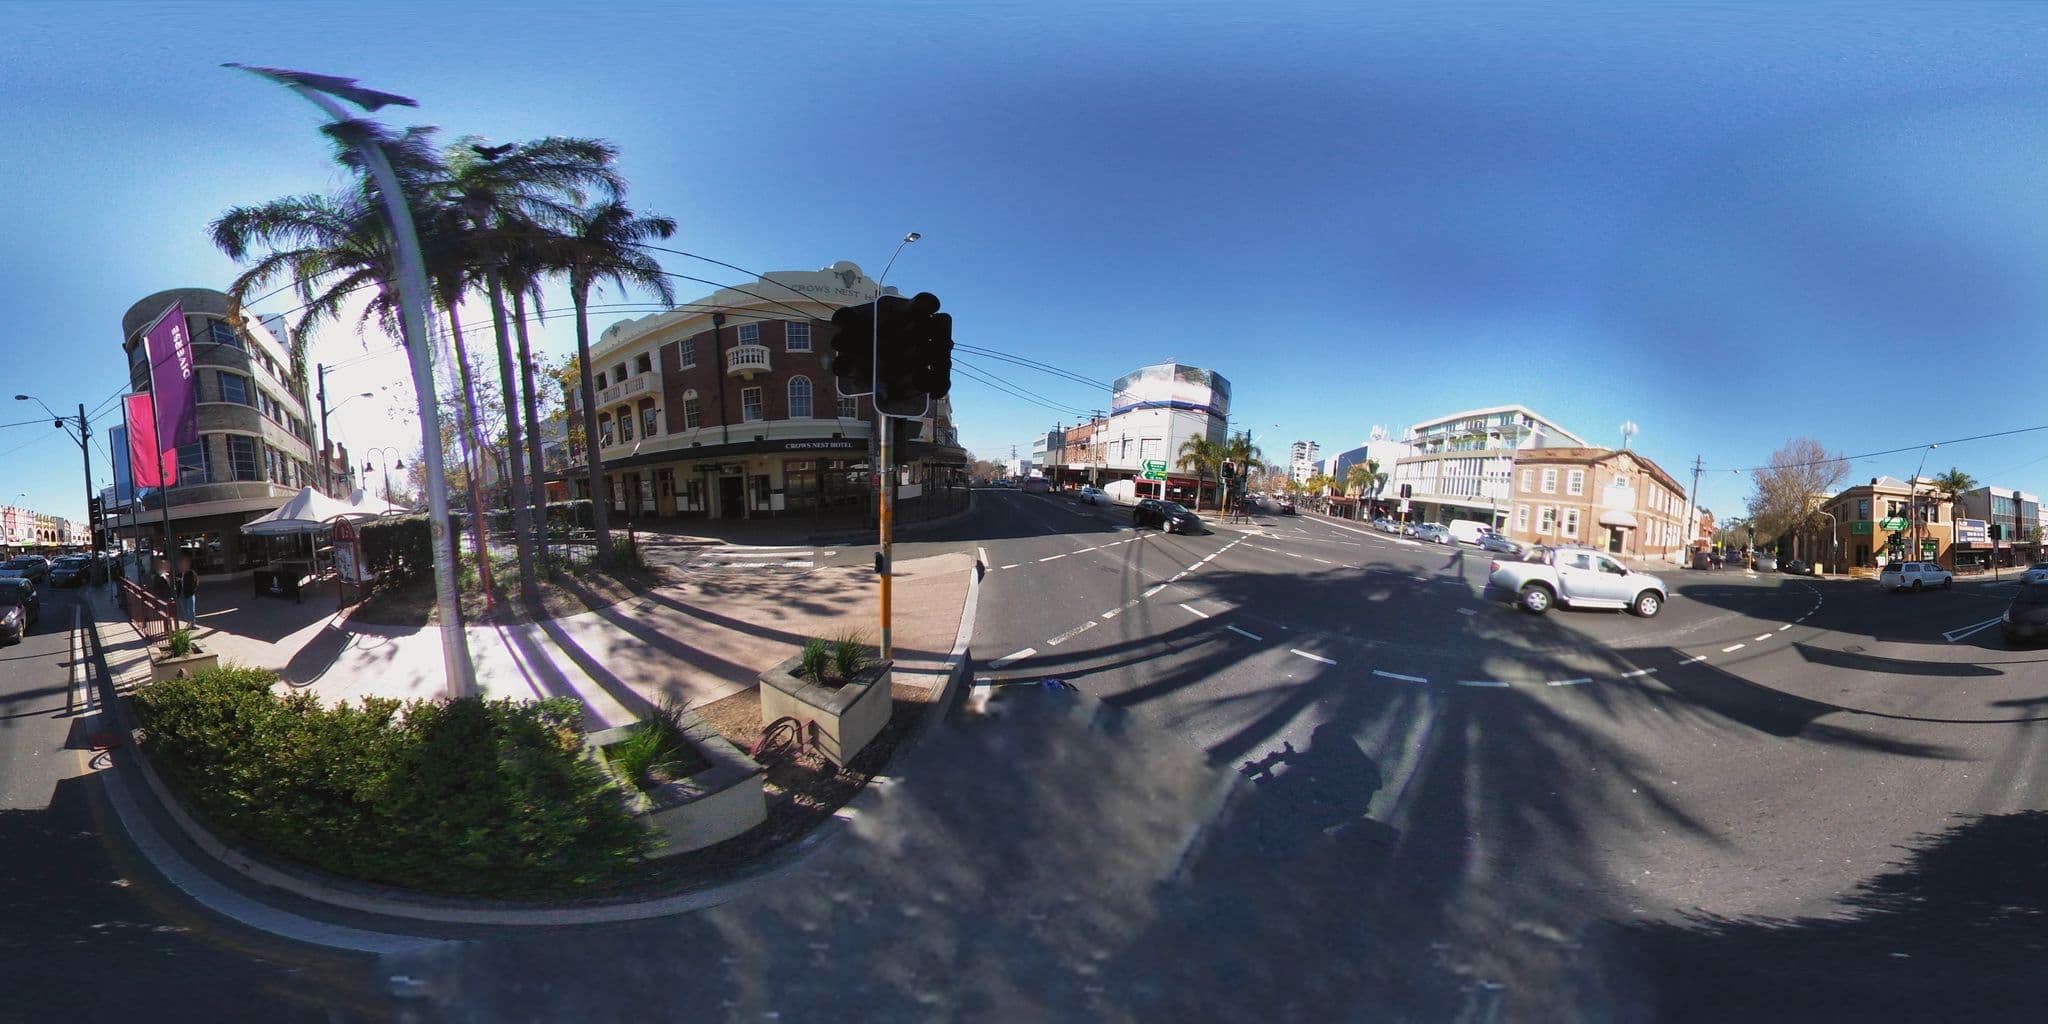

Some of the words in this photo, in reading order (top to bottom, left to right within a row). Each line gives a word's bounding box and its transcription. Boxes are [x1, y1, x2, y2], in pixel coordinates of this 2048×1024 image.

[792, 284, 830, 294] CROWS
[835, 287, 860, 298] NEST
[171, 325, 190, 380] DIVERSE
